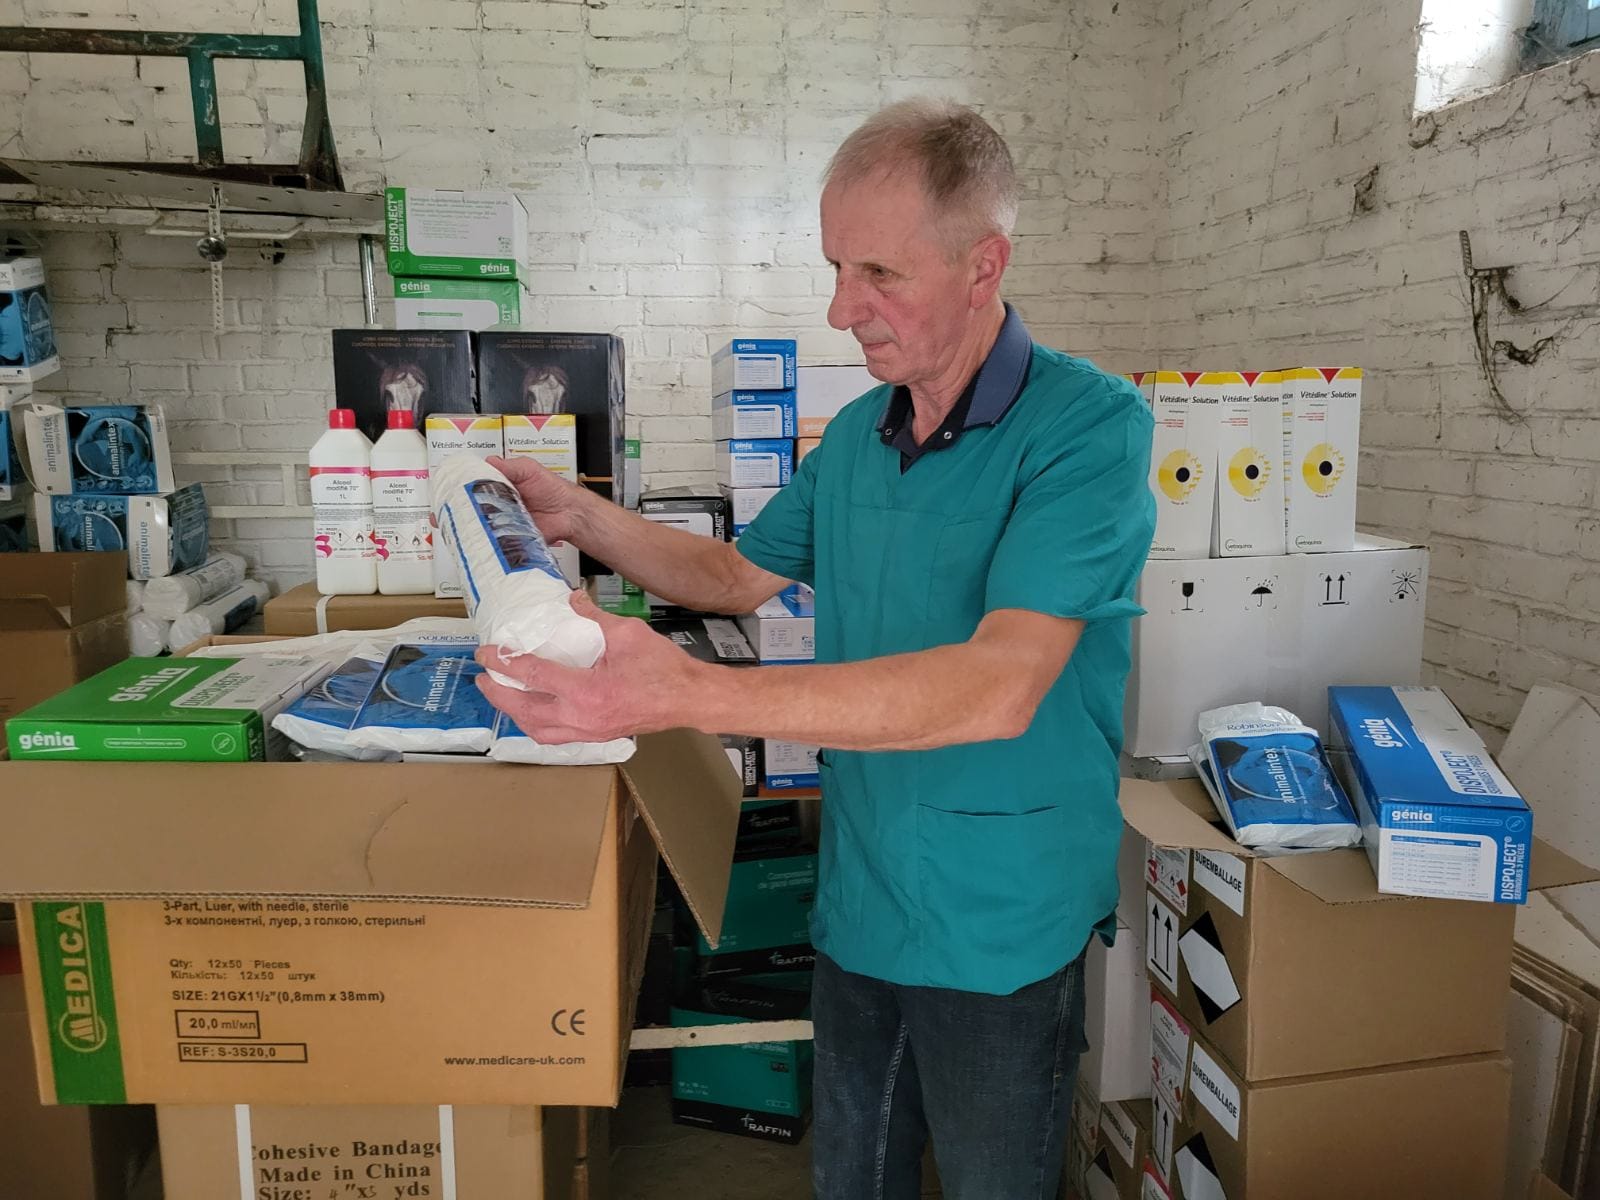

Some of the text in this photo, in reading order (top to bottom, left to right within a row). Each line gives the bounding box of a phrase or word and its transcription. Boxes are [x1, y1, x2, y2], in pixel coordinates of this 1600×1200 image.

[480, 263, 510, 274] génia
[400, 282, 430, 292] génia
[1191, 396, 1219, 404] Solution
[1253, 395, 1279, 403] Solution
[1331, 390, 1357, 399] Solution
[43, 416, 56, 472] animalintex
[107, 421, 120, 475] animalintex
[467, 441, 496, 449] Solution
[140, 522, 151, 577] animalinte
[108, 667, 188, 702] génia
[423, 657, 454, 711] animalintex
[1227, 722, 1280, 731] Robinson
[1360, 719, 1403, 748] génia
[19, 732, 75, 749] génia
[1263, 748, 1296, 804] animalintex
[1391, 810, 1433, 821] génia
[1195, 850, 1242, 893] SUREMBALLAGE
[162, 901, 349, 912] 3-Part, Luer, with needle, sterile
[186, 916, 266, 927] компонентні,
[314, 917, 362, 927] голкою,
[365, 915, 426, 928] стерильні
[169, 959, 290, 969] Qty: 12x50 Pieces
[56, 905, 95, 1042] MEDICA
[170, 971, 316, 982] Кількість: 12x50 штук
[172, 991, 208, 1001] SIZE:
[340, 991, 385, 1003] 38mm)
[189, 1018, 218, 1030] 20,0
[551, 1009, 585, 1036] CE
[183, 1046, 276, 1058] REF: S-3S20,0
[444, 1056, 586, 1065] www.medicare-uk.com
[1192, 1060, 1237, 1119] SUREMBALLAGE
[260, 1163, 431, 1183] Made in China
[259, 1186, 312, 1200] Size:
[395, 1182, 430, 1200] yds
